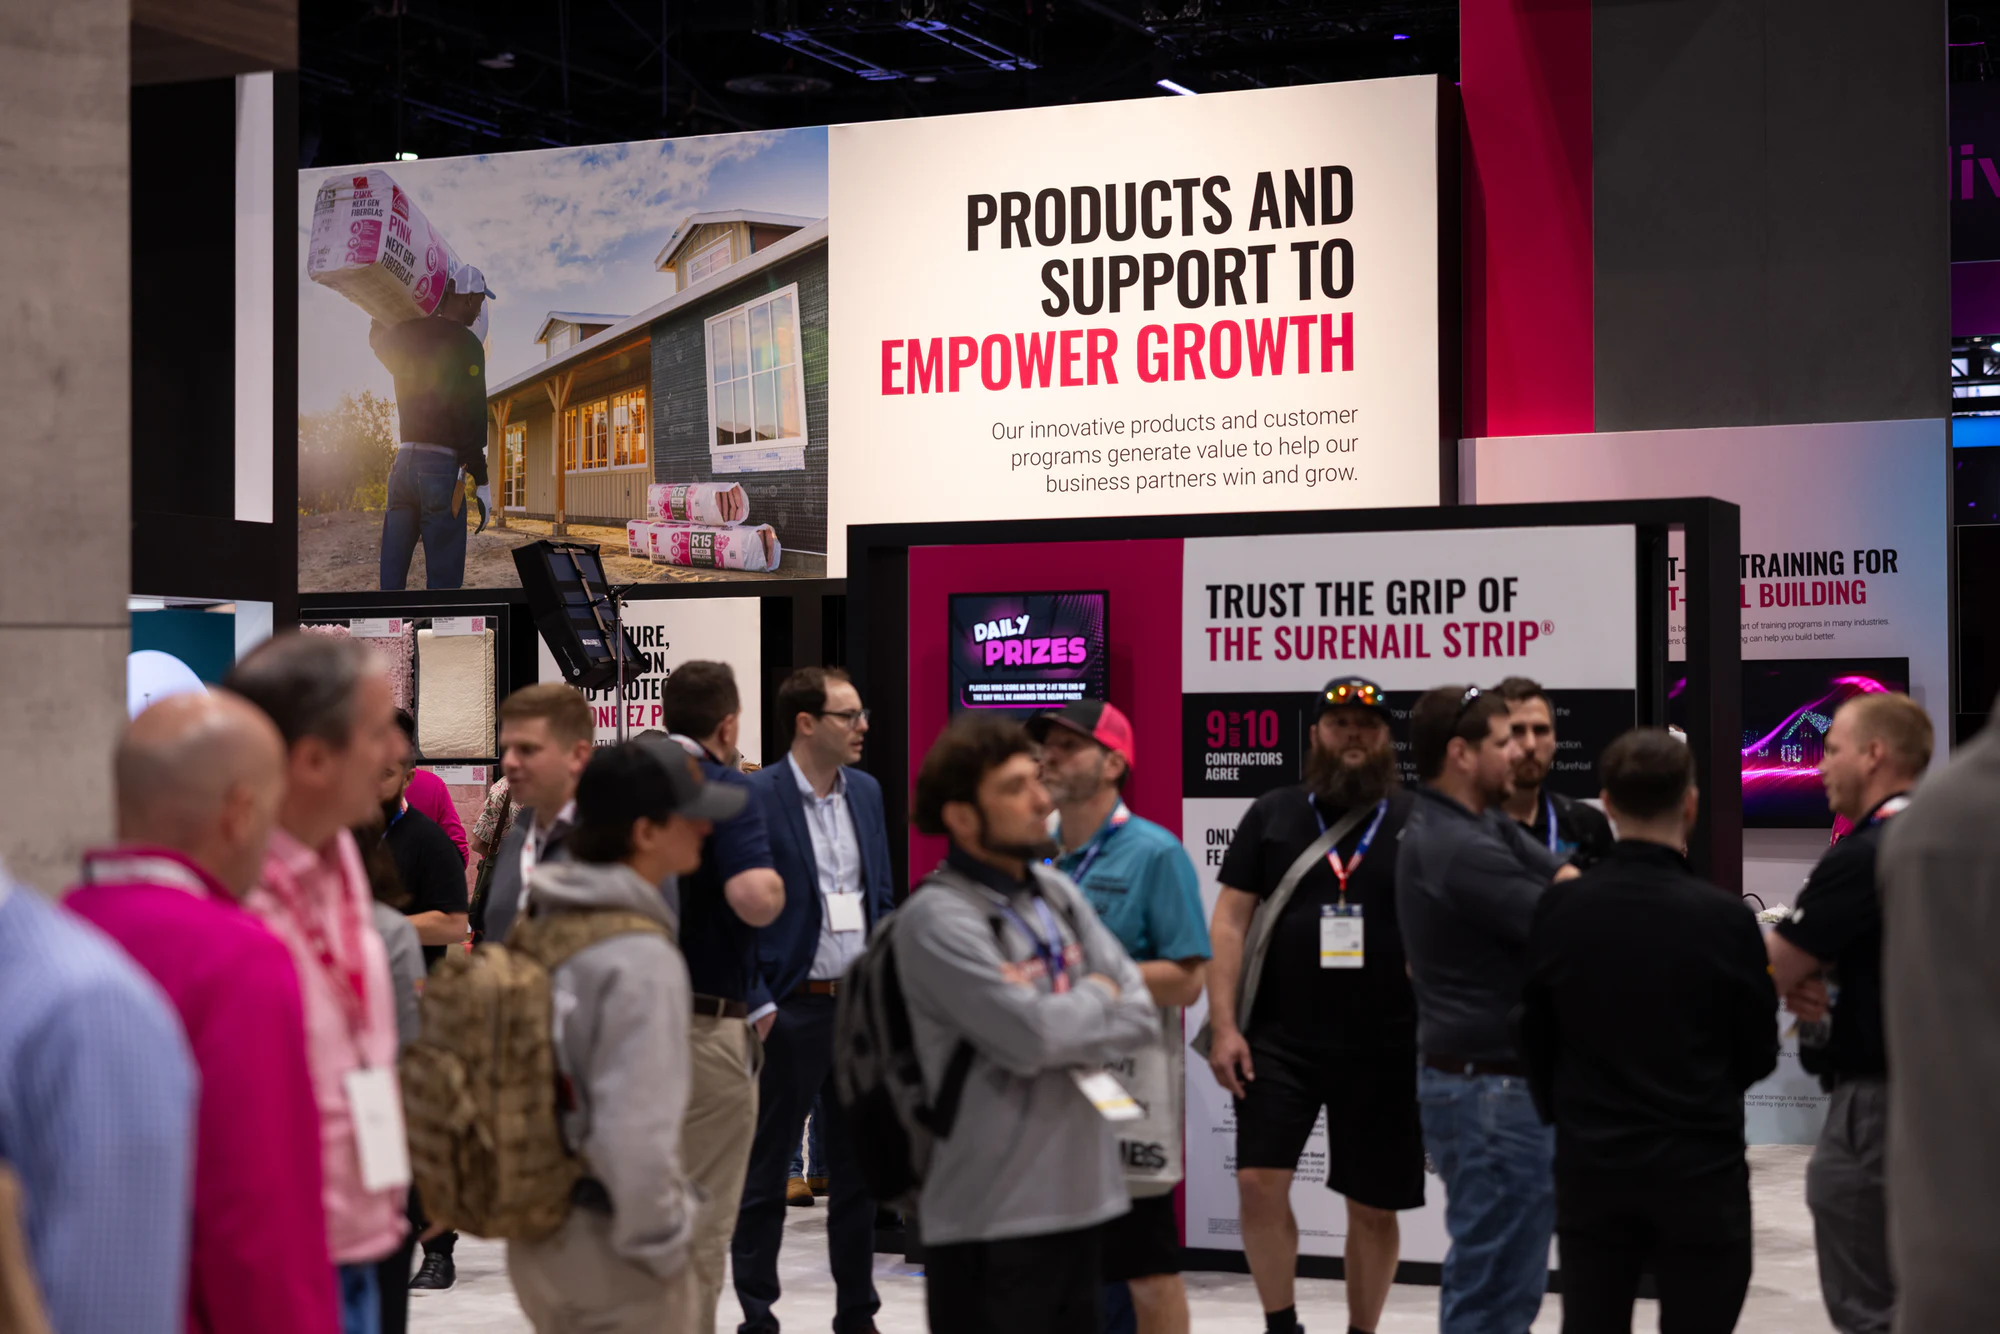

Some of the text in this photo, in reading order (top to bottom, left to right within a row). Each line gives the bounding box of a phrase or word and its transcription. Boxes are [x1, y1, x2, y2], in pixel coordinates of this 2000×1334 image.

[352, 199, 380, 208] NEXT GEN
[353, 190, 373, 199] PINK
[967, 165, 1354, 251] PRODUCTS AND
[389, 215, 412, 246] PINK
[386, 235, 416, 268] NEXT GEN
[1041, 238, 1354, 318] SUPPORT TO
[881, 312, 1354, 396] EMPOWER GROWTH
[991, 408, 1359, 441] Our innovative products and customer
[1011, 436, 1359, 472] programs generate value to help our
[672, 486, 687, 497] R15
[1046, 465, 1358, 494] business partners win and grow.
[691, 534, 712, 547] R15
[1740, 549, 1898, 578] TRAINING FOR
[1205, 577, 1518, 619] TRUST THE GRIP OF
[1759, 580, 1866, 608] BUILDING
[974, 615, 1030, 642] DAILY
[1761, 621, 1786, 630] training
[1788, 620, 1822, 631] programs
[1832, 620, 1853, 629] many
[1854, 618, 1890, 626] industries.
[1764, 634, 1779, 643] help
[1781, 635, 1794, 643] you
[1795, 633, 1812, 641] build
[1813, 633, 1836, 641] better.
[985, 637, 1087, 666] PRIZES
[1205, 626, 1263, 661] THE
[1274, 623, 1431, 660] SURENAIL
[627, 705, 645, 727] EZ
[1556, 708, 1570, 716] the
[1206, 709, 1226, 748] 9
[1229, 728, 1240, 747] OUT
[1243, 709, 1279, 748] 10
[1205, 752, 1283, 766] CONTRACTORS
[1556, 761, 1591, 771] SureNail
[1205, 768, 1240, 781] AGREE
